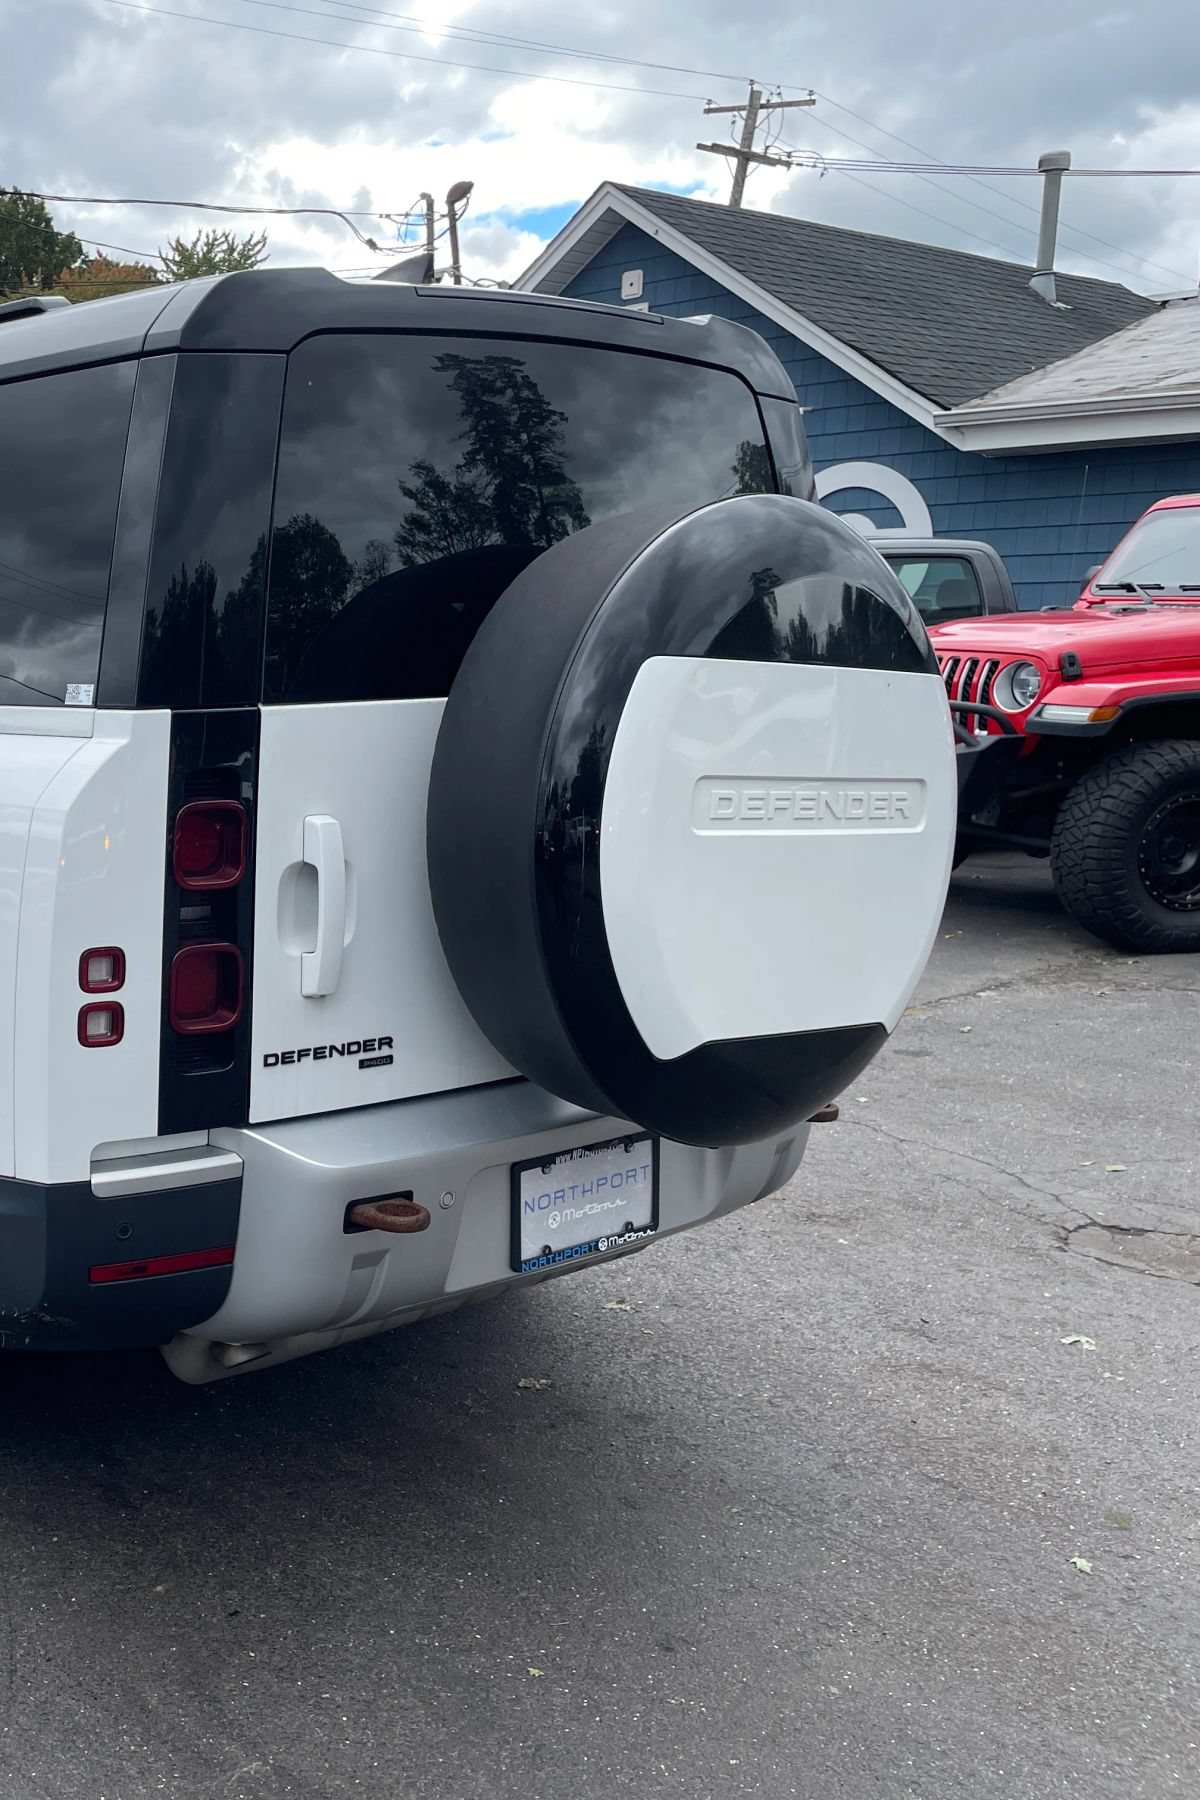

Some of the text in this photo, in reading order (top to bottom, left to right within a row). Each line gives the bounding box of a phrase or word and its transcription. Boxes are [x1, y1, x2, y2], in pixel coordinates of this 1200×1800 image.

[710, 790, 908, 820] DEFENDER
[264, 1036, 393, 1067] DEFENDER
[364, 1057, 391, 1068] P400
[524, 1164, 650, 1215] NORTHPORT
[521, 1242, 597, 1273] NORTHPORT
